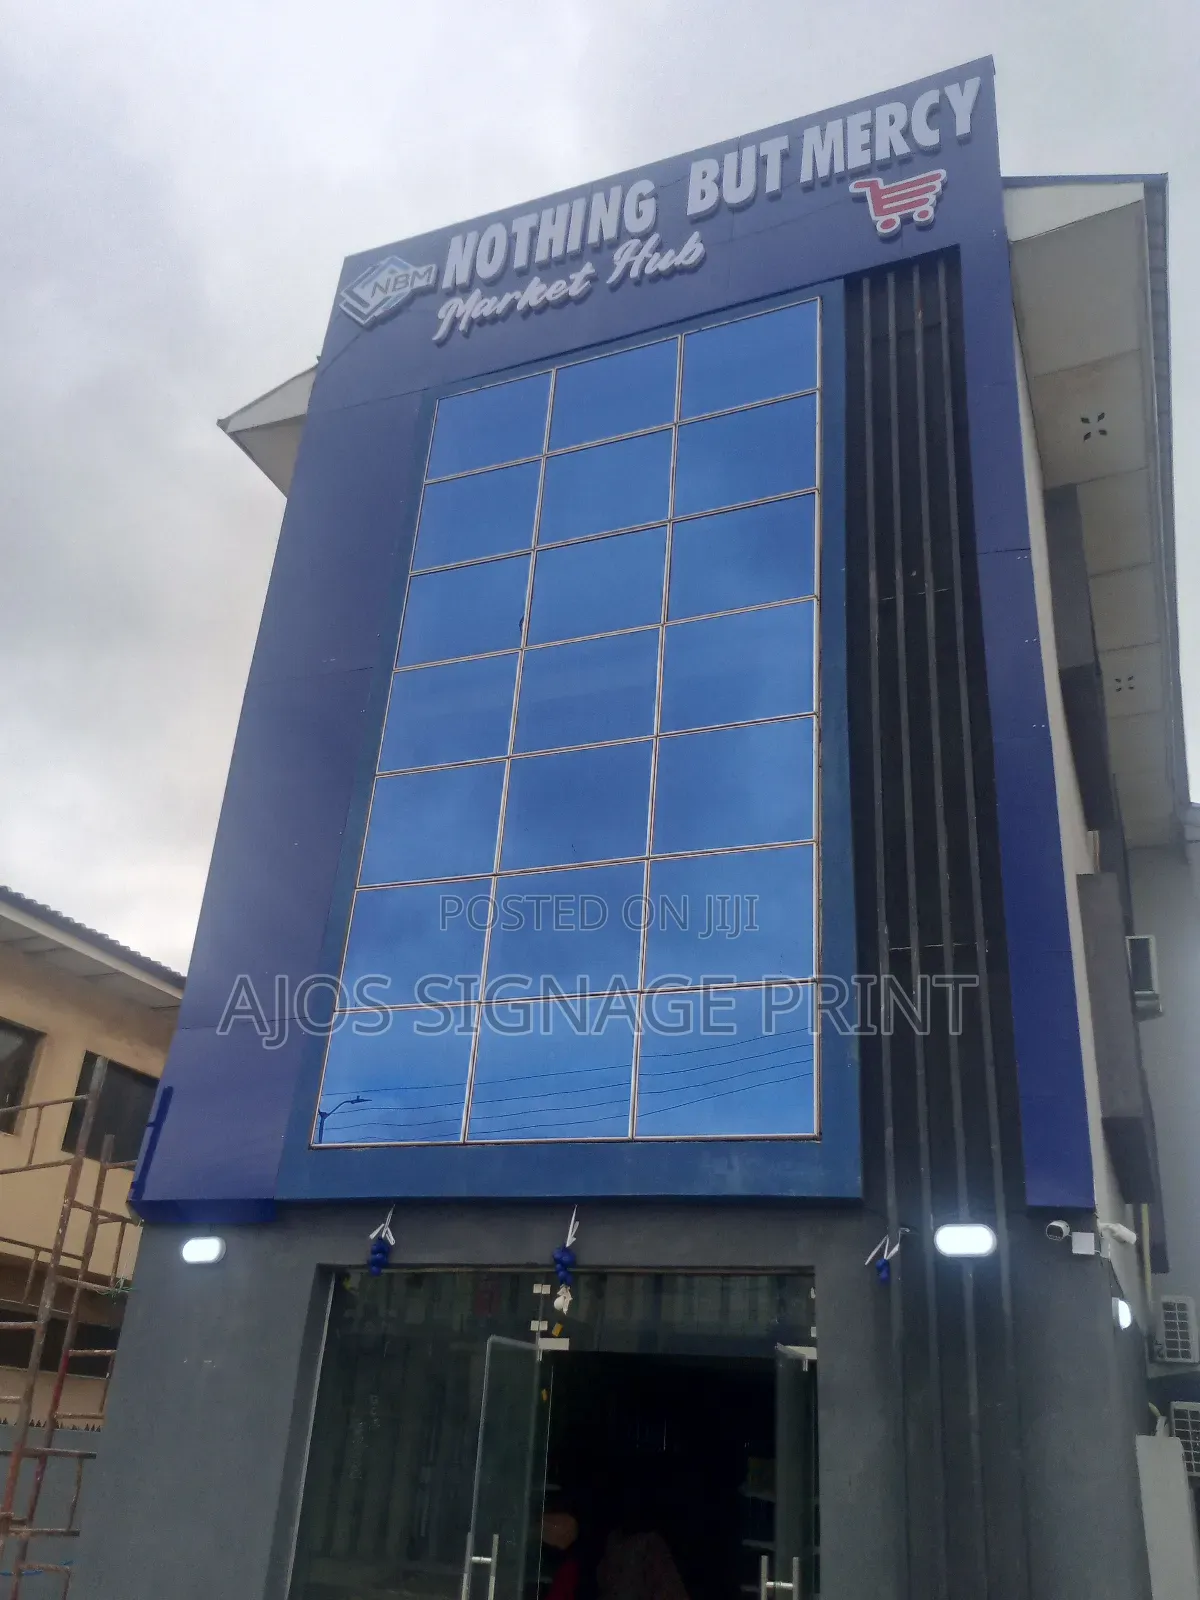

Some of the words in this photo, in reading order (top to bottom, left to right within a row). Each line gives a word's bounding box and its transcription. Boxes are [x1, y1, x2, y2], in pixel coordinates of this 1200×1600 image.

[442, 179, 656, 289] NOTHING
[686, 134, 791, 216] BUT
[799, 77, 981, 183] MERCY
[370, 265, 434, 298] NBM
[432, 262, 597, 342] Market
[607, 232, 705, 284] Hub
